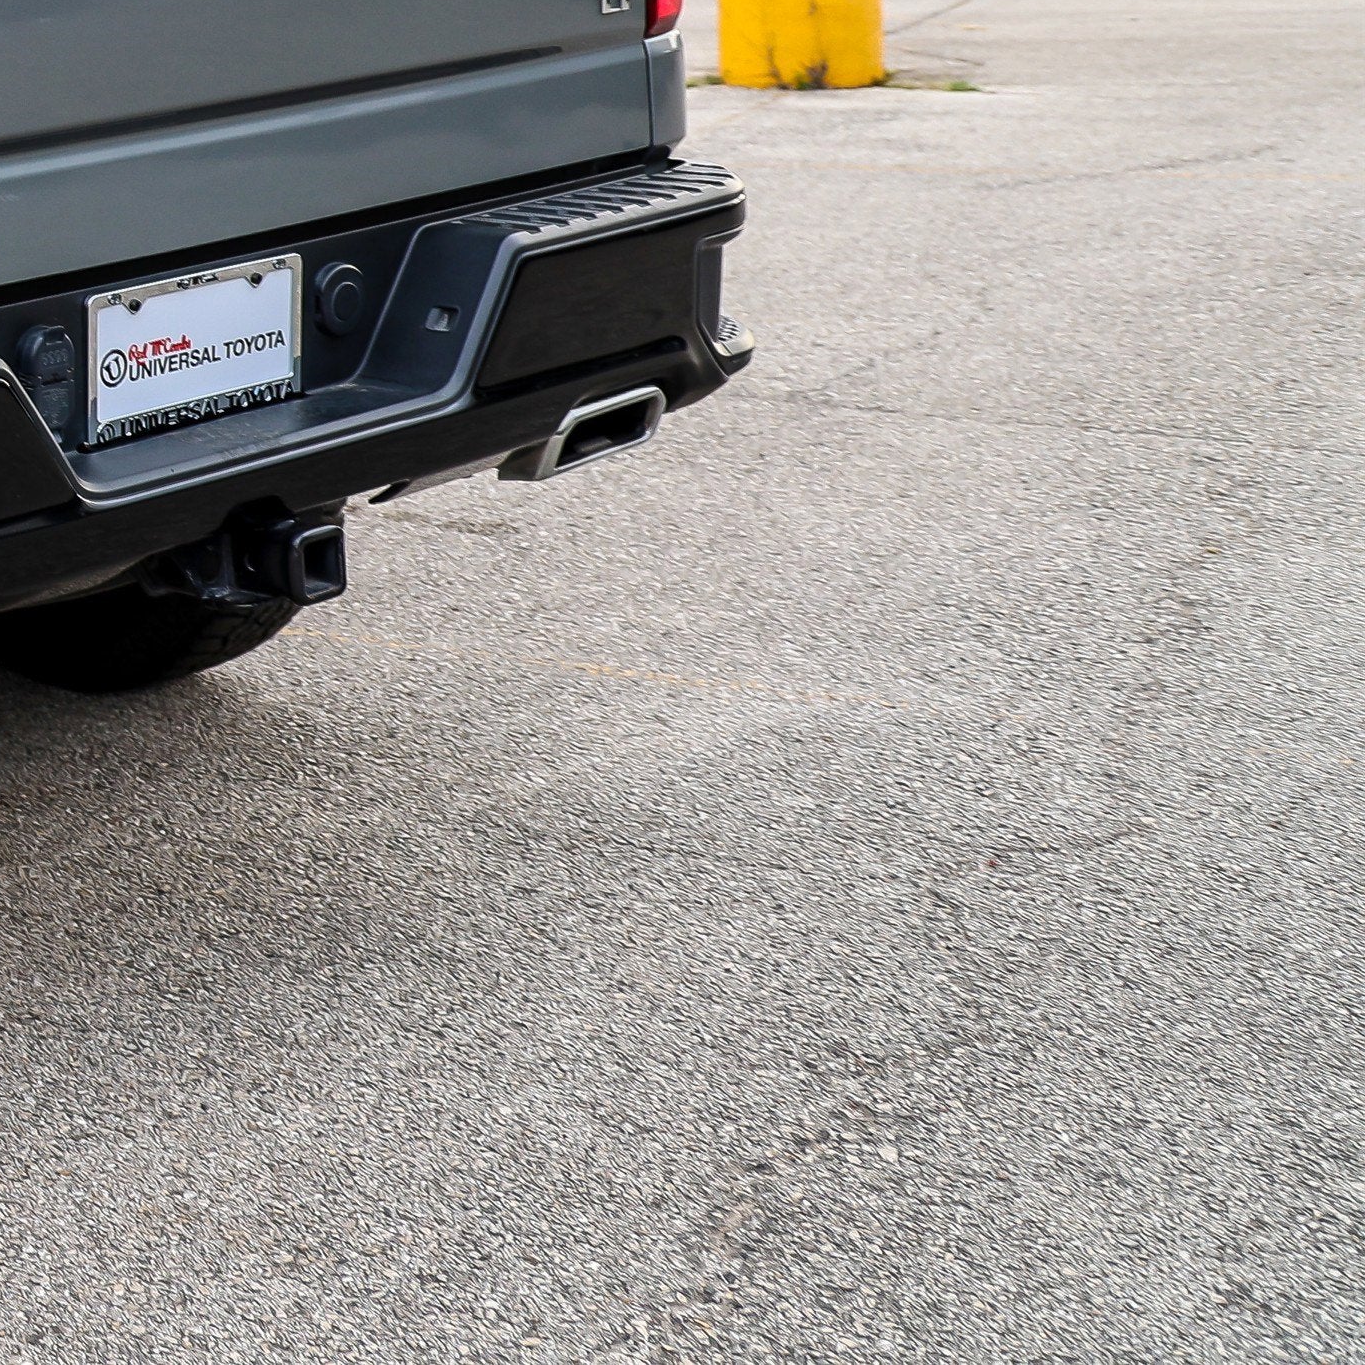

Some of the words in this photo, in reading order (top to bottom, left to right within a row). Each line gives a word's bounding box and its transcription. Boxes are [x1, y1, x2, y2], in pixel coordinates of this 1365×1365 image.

[128, 342, 148, 367] Red
[128, 346, 221, 382] UNIVERSAL
[223, 329, 287, 359] TOYOTA
[121, 395, 225, 436] UNIVERSAL
[225, 379, 295, 409] TOYOTA
